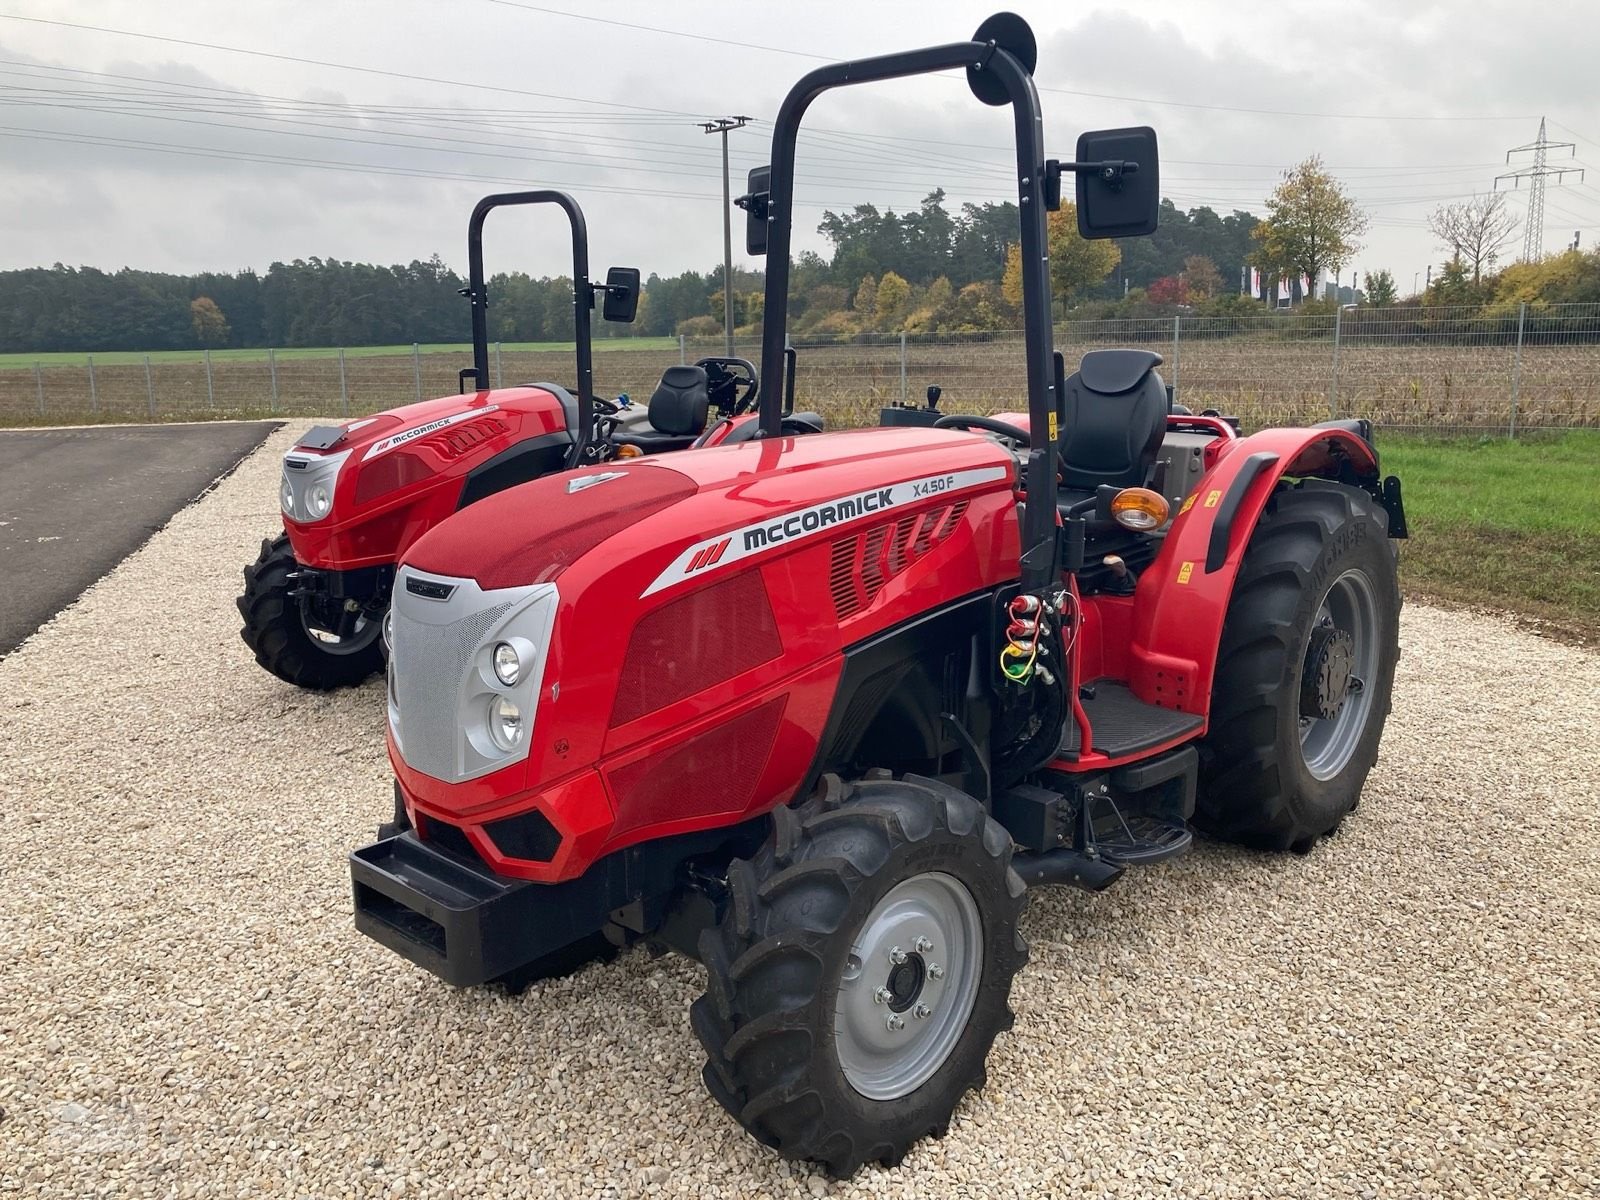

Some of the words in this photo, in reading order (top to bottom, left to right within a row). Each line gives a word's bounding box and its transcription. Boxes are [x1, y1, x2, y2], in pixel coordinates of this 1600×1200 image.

[393, 418, 451, 444] McCORMICK
[743, 488, 894, 551] McCORMICK
[946, 476, 954, 489] F
